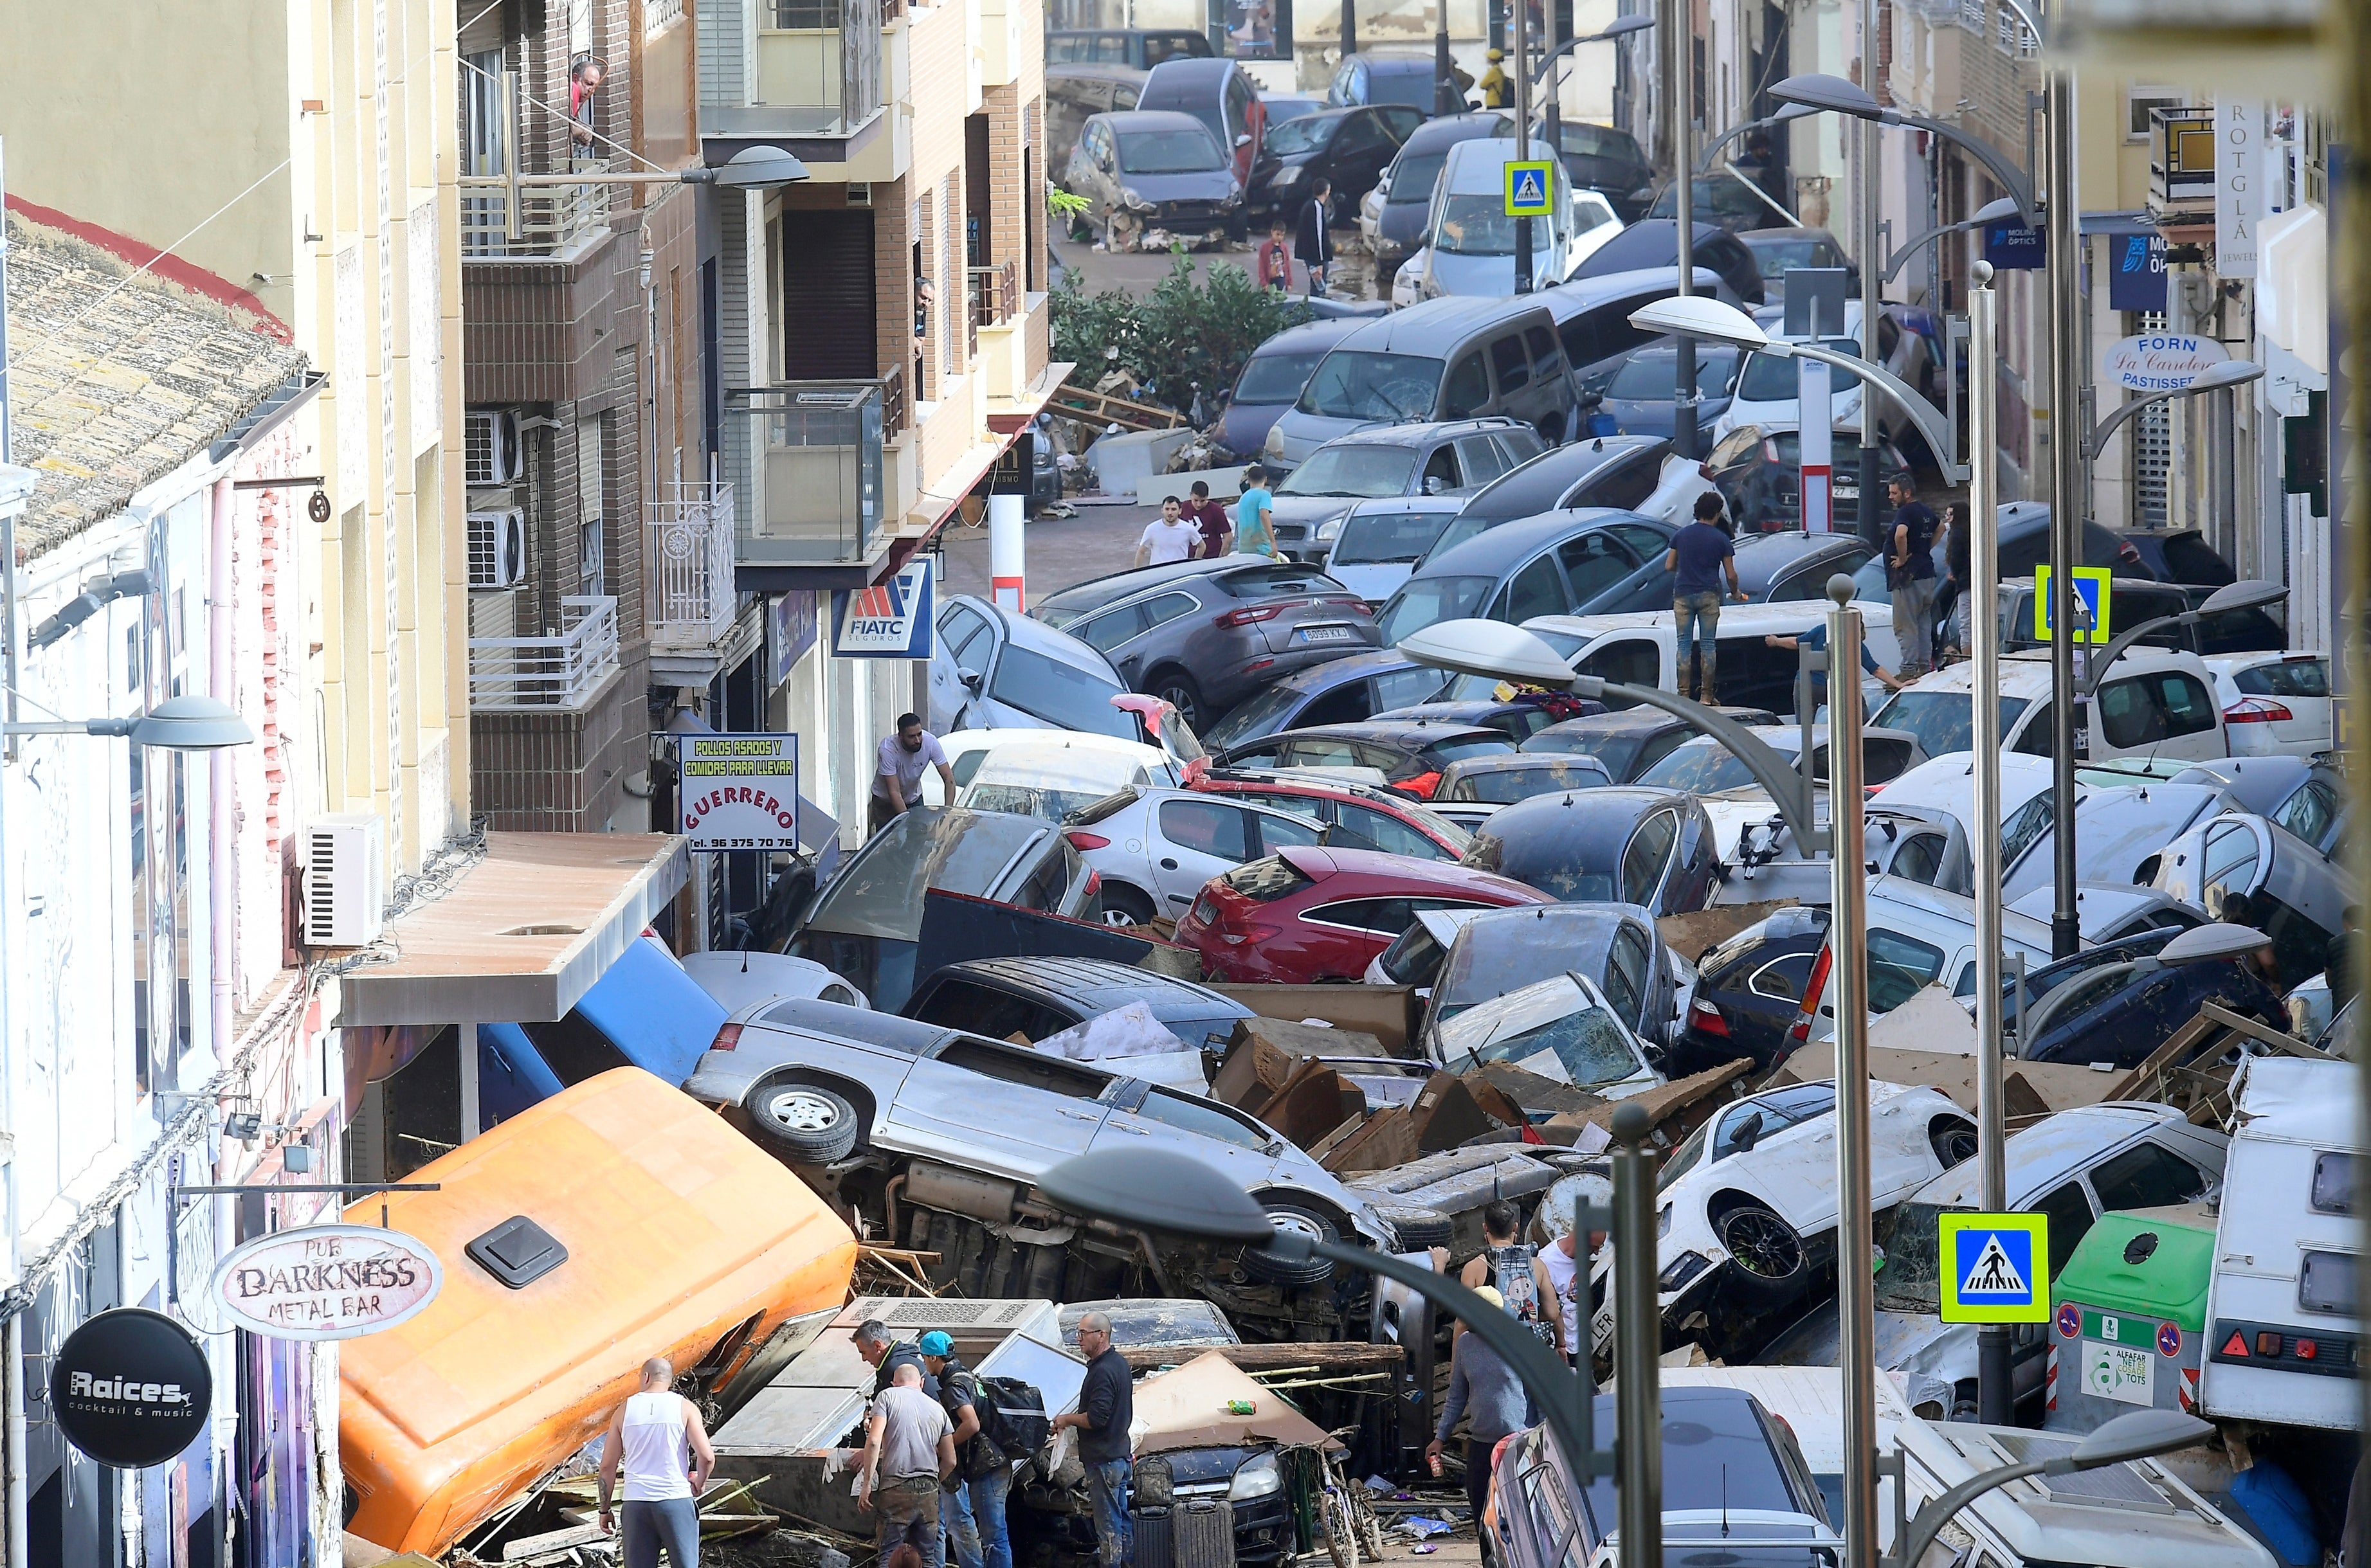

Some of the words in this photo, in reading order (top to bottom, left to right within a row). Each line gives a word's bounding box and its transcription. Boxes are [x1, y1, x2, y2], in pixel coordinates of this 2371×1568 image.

[2230, 105, 2248, 240] ROTGLÁ
[2138, 338, 2197, 352] FORN
[2114, 352, 2137, 370] La
[850, 620, 904, 635] FIATC
[1306, 629, 1329, 639] 8099
[1329, 627, 1348, 638] KXJ
[695, 740, 732, 757] POLLOS
[733, 740, 772, 756] ASADOS
[773, 739, 783, 756] Y
[684, 761, 727, 777] COMIDAS
[728, 761, 755, 776] PARA
[756, 760, 793, 776] LLEVAR
[686, 786, 794, 830] GUERRERO
[690, 838, 707, 847] Tel.
[711, 838, 727, 847] 96
[731, 838, 754, 847] 375
[758, 838, 774, 847] 70
[777, 838, 793, 847] 76
[305, 1238, 342, 1260] PUB
[237, 1257, 415, 1298] DARKNESS
[269, 1297, 334, 1323] METAL
[341, 1295, 385, 1318] BAR
[1591, 1313, 1614, 1340] LFR
[2116, 1349, 2146, 1362] ALFAFAR
[2122, 1358, 2136, 1367] NET
[2138, 1360, 2146, 1369] ES
[70, 1371, 182, 1403] Raices
[2126, 1373, 2146, 1385] TOTS
[68, 1401, 126, 1415] cocktail
[134, 1407, 143, 1416] &
[151, 1408, 193, 1418] music
